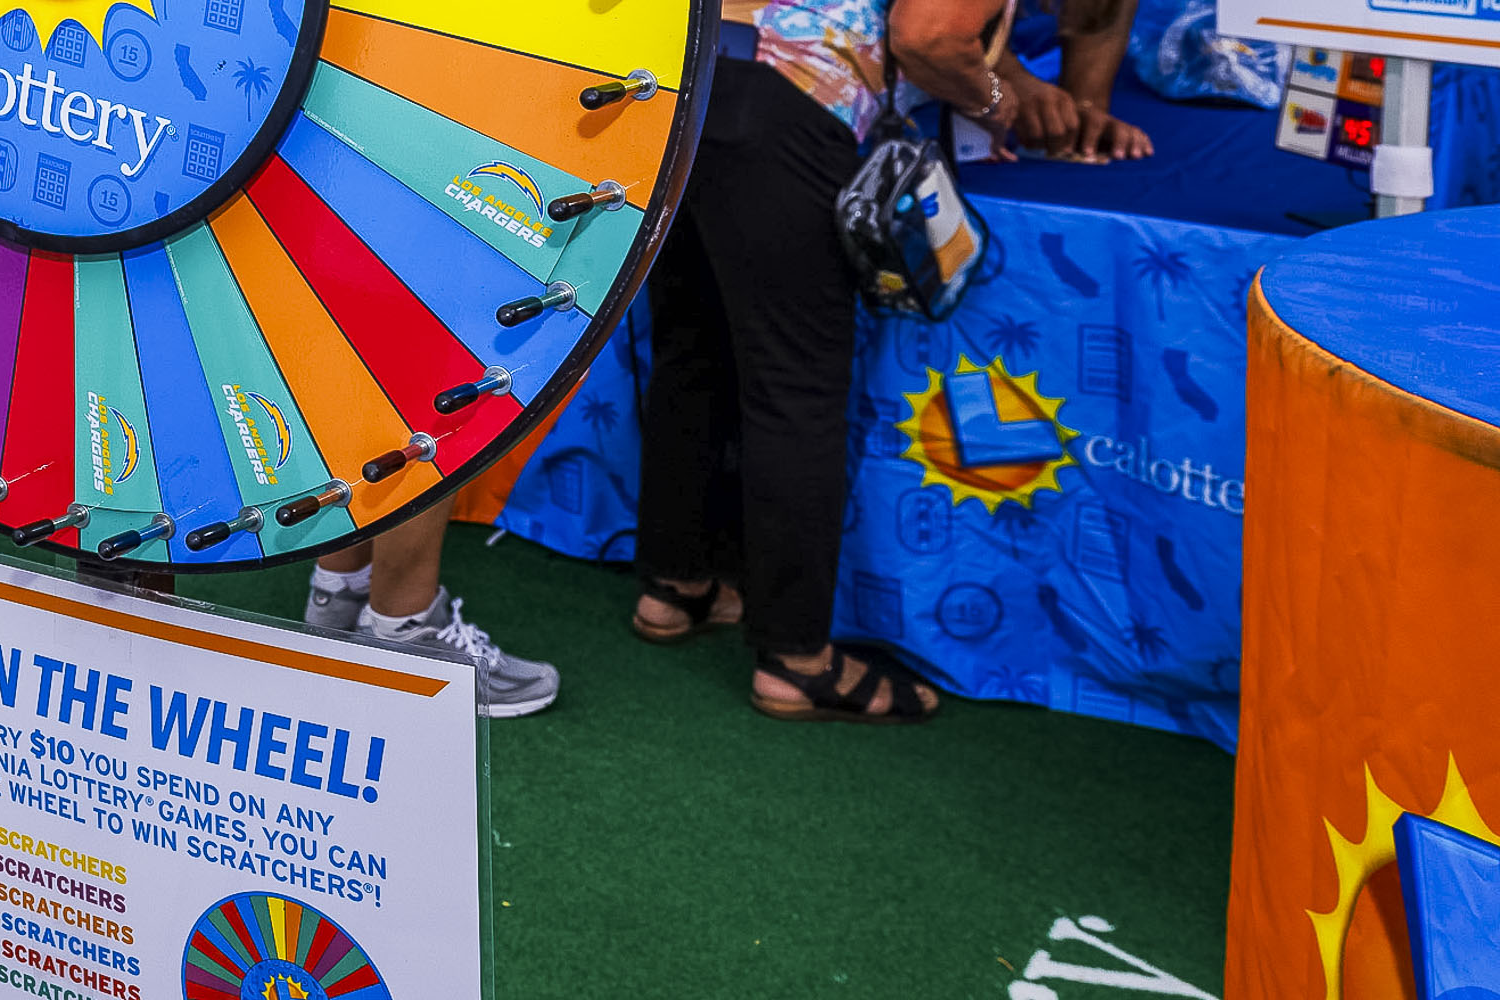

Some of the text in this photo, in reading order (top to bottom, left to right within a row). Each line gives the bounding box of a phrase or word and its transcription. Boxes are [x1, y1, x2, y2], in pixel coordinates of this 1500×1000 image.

[120, 45, 139, 63] 15
[100, 190, 118, 207] 15
[444, 183, 547, 248] CHARGERS
[452, 175, 554, 238] LOS ANGELES
[84, 391, 105, 493] CHARGERS
[222, 384, 269, 485] CHARGERS
[233, 384, 278, 485] LOS ANGELES
[1084, 435, 1245, 514] calotte
[33, 654, 133, 741] THE
[150, 684, 386, 803] WHEEL!
[9, 780, 86, 824] WHEEL
[93, 807, 123, 835] TO
[131, 818, 177, 851] WIN
[30, 729, 75, 765] $10
[80, 748, 127, 780] YOU
[136, 766, 220, 806] SPEND
[229, 791, 265, 820] ON
[276, 803, 334, 836] ANY
[158, 800, 254, 849] GAMES,
[263, 826, 317, 860] YOU
[329, 845, 387, 879] CAN
[1, 912, 141, 976] SCRATCHERS
[2, 939, 142, 1000] SCRATCHERS
